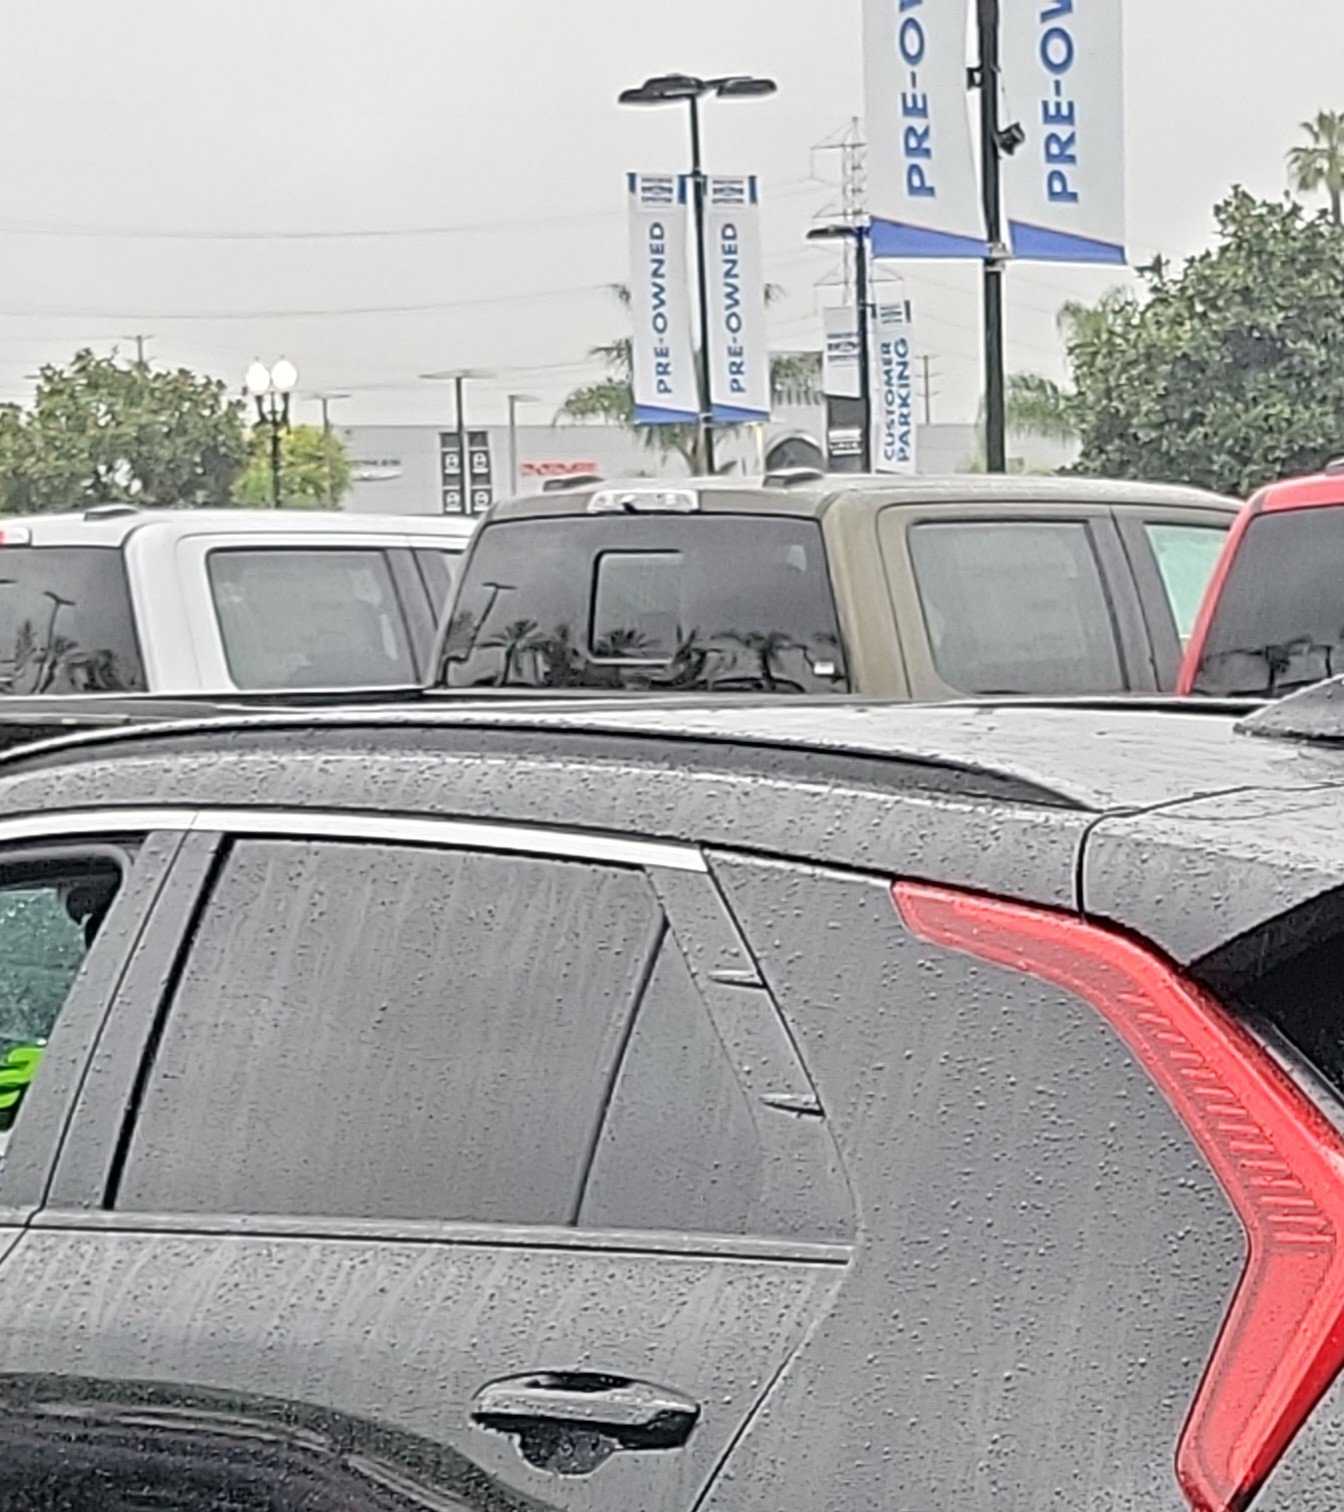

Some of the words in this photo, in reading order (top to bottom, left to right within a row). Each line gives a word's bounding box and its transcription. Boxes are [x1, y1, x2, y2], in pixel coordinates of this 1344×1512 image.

[899, 0, 936, 198] PRE-O
[649, 221, 672, 394] PRE-OWNED
[721, 222, 746, 394] PRE-OWNED
[880, 341, 895, 462] CUSTOMER
[895, 337, 911, 462] PARKING
